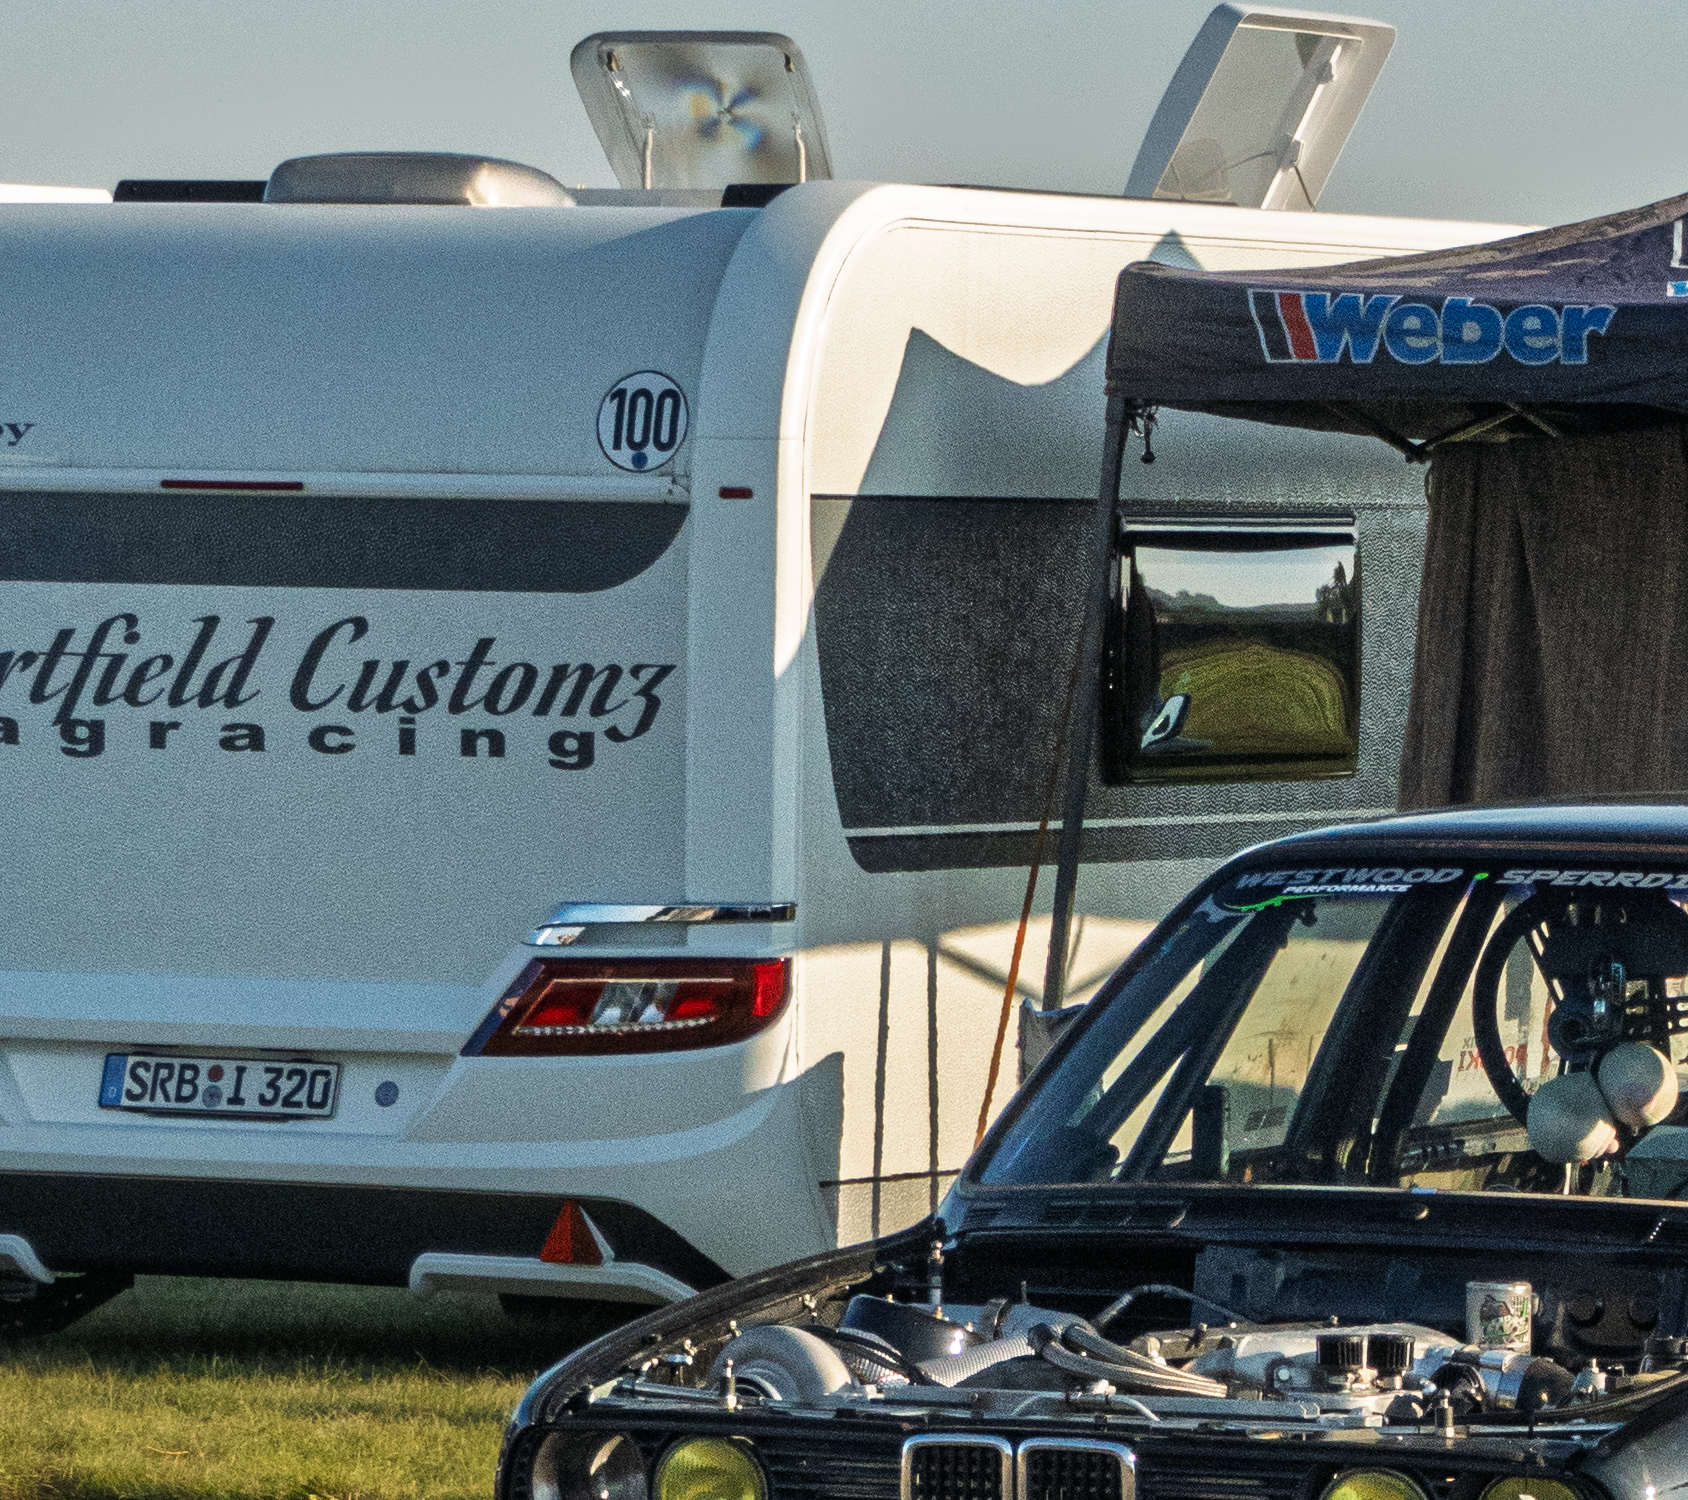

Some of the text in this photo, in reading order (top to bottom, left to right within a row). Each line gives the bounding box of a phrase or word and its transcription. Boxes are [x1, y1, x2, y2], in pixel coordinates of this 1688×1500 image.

[1300, 293, 1618, 366] Weber
[609, 388, 682, 452] 100
[288, 614, 677, 743] Customz
[1235, 867, 1464, 891] WESTWOOD
[1282, 883, 1413, 895] PERFORMANCE
[124, 1060, 333, 1110] SRB I 320
